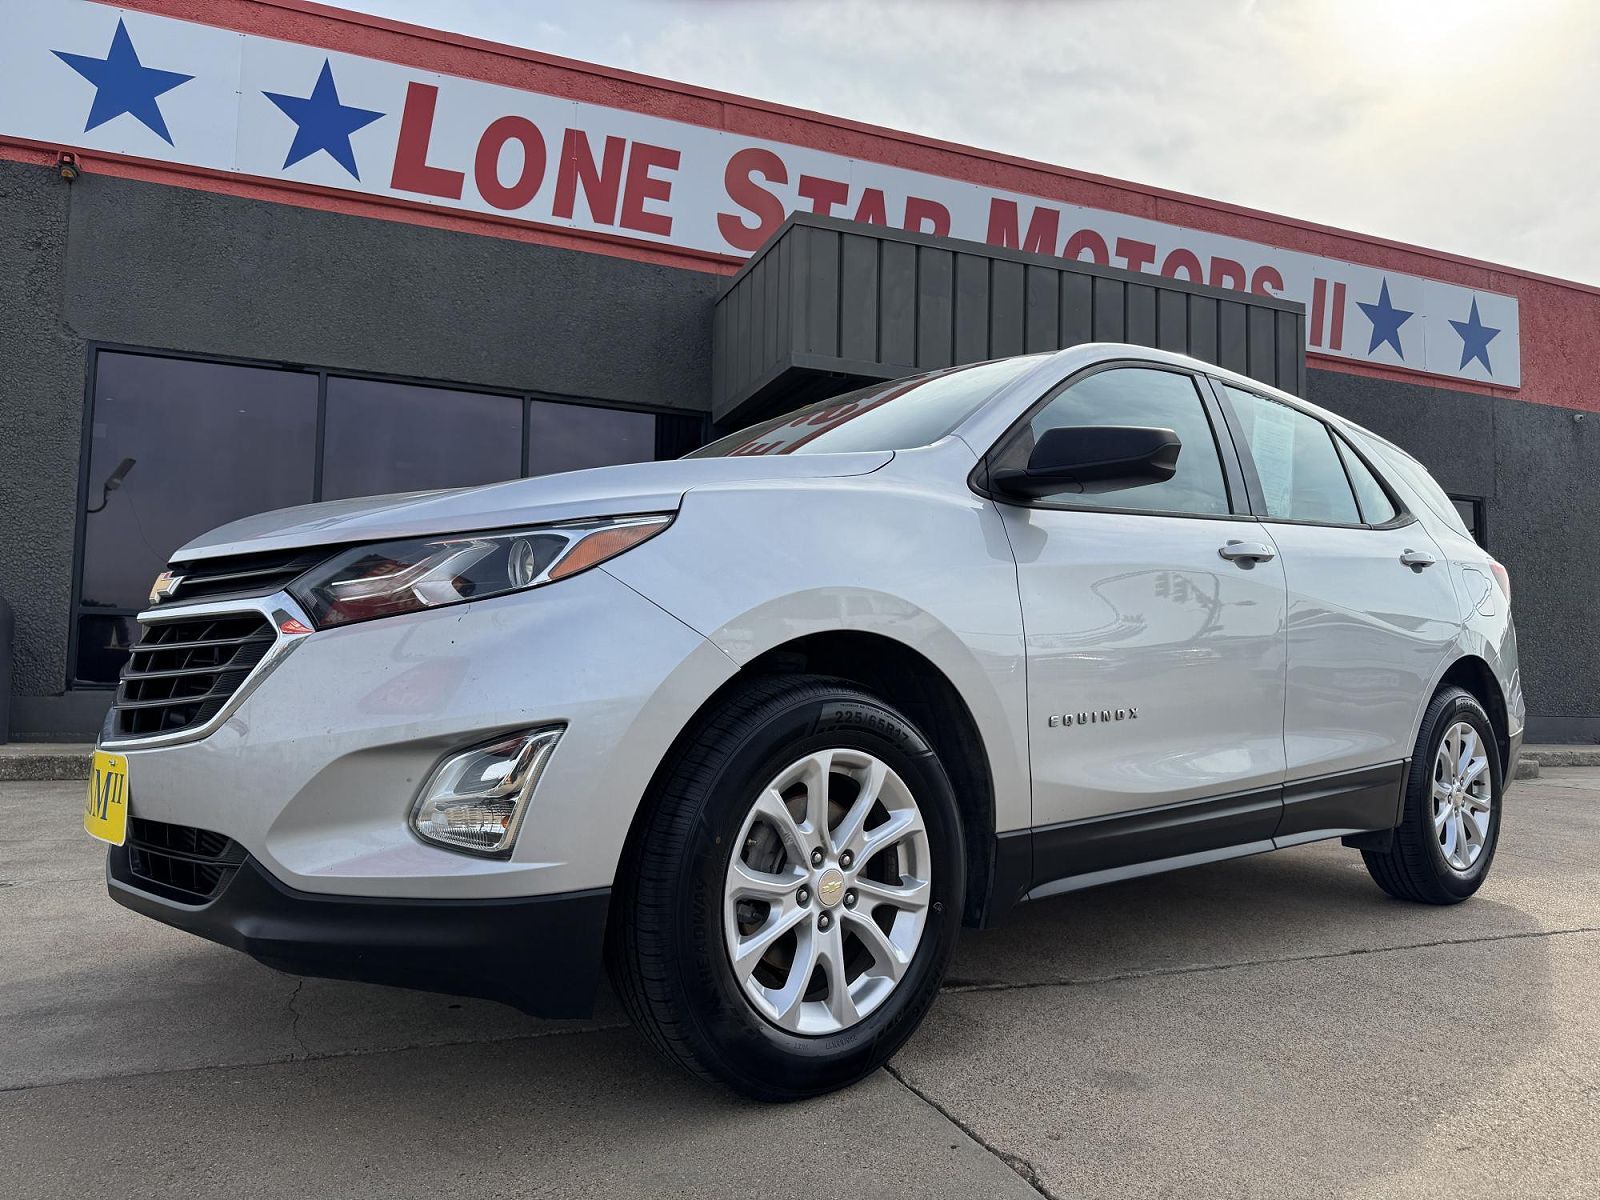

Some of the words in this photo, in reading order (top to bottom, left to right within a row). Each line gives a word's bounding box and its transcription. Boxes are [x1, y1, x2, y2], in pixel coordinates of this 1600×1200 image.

[390, 81, 681, 237] LONE
[1309, 278, 1346, 350] II
[1048, 707, 1139, 728] EQUINOX
